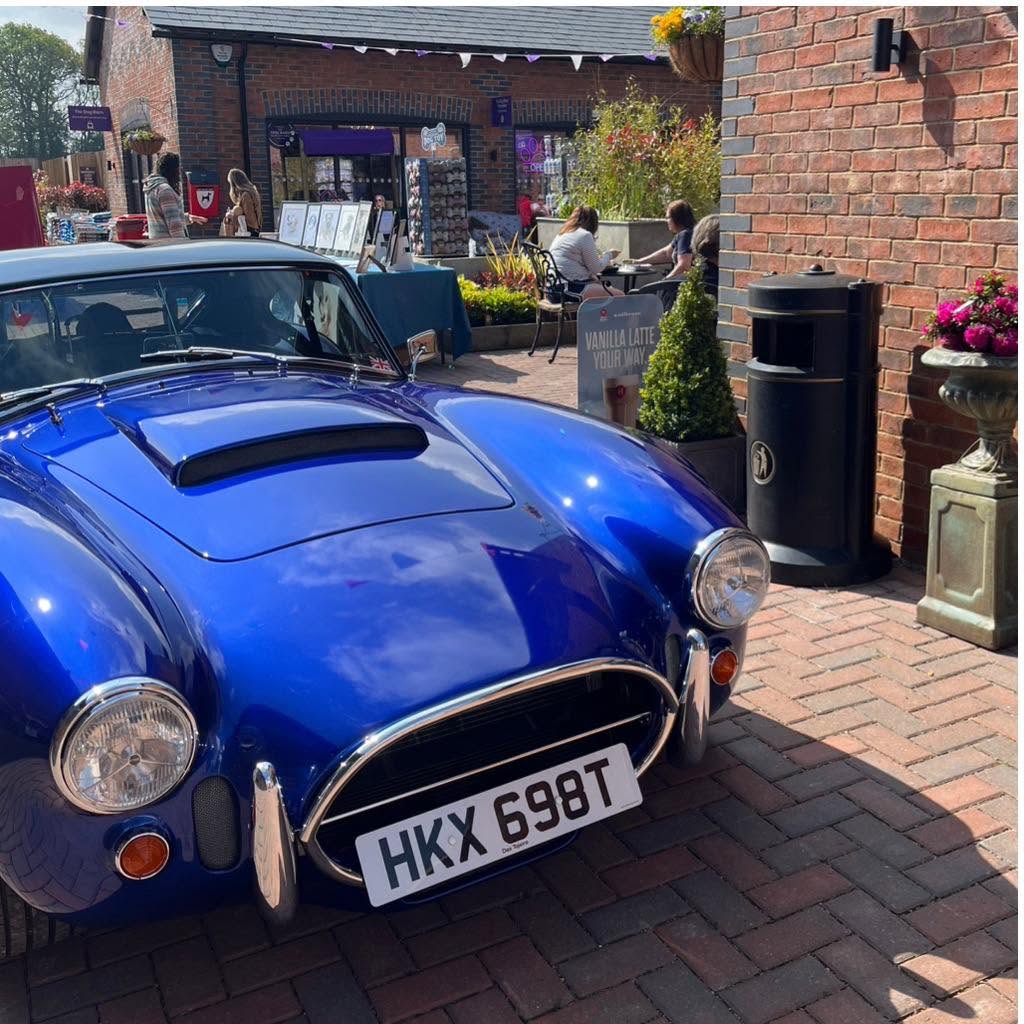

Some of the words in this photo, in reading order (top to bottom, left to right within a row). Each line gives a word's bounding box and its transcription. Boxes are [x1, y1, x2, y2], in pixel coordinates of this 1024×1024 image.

[530, 163, 544, 172] OPE
[585, 329, 626, 351] VANILLA
[628, 326, 655, 346] LATTE
[593, 349, 621, 370] YOUR
[623, 346, 648, 366] WAY.
[378, 805, 487, 890] HKX
[493, 757, 609, 844] 698T
